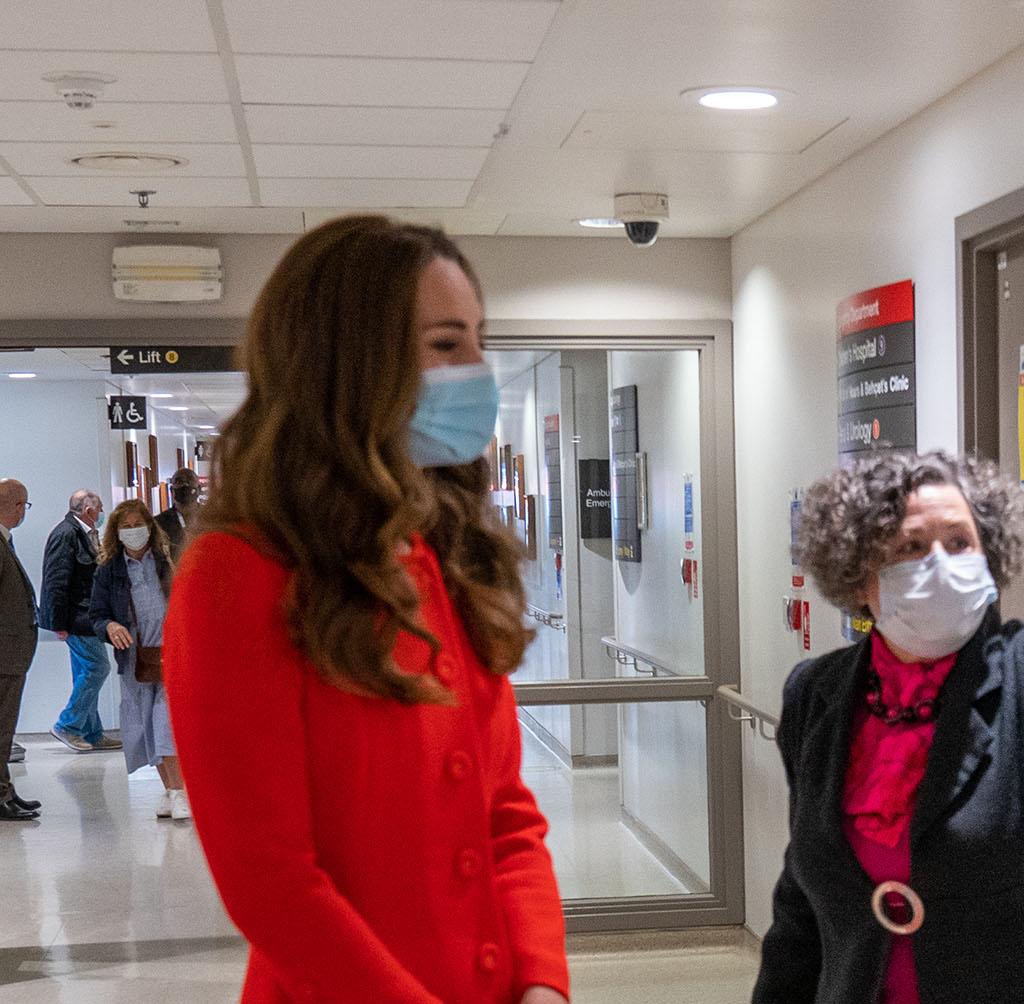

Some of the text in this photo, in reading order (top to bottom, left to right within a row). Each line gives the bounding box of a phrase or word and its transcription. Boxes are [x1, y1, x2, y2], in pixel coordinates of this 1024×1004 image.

[139, 350, 161, 363] Lift
[853, 337, 877, 363] Hospital
[889, 375, 909, 392] Clinic
[850, 421, 872, 445] Urology
